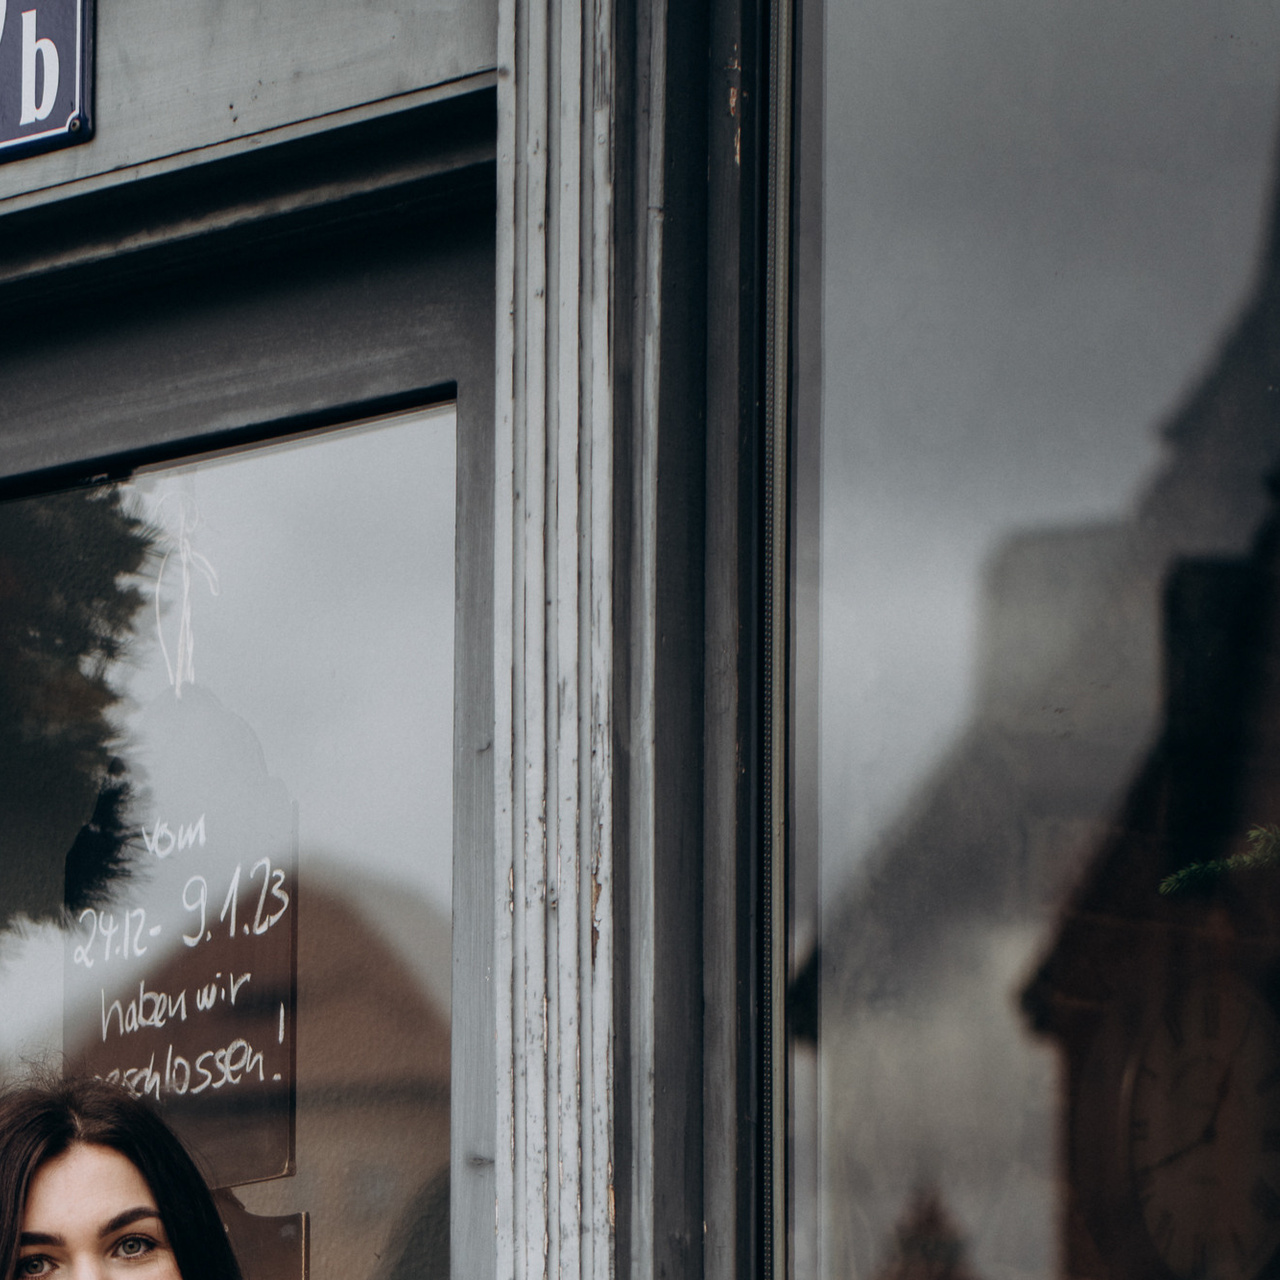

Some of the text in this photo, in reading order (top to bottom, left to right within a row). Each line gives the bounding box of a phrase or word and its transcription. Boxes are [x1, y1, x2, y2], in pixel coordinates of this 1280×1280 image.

[141, 813, 207, 858] vom
[101, 972, 251, 1043] haben wir
